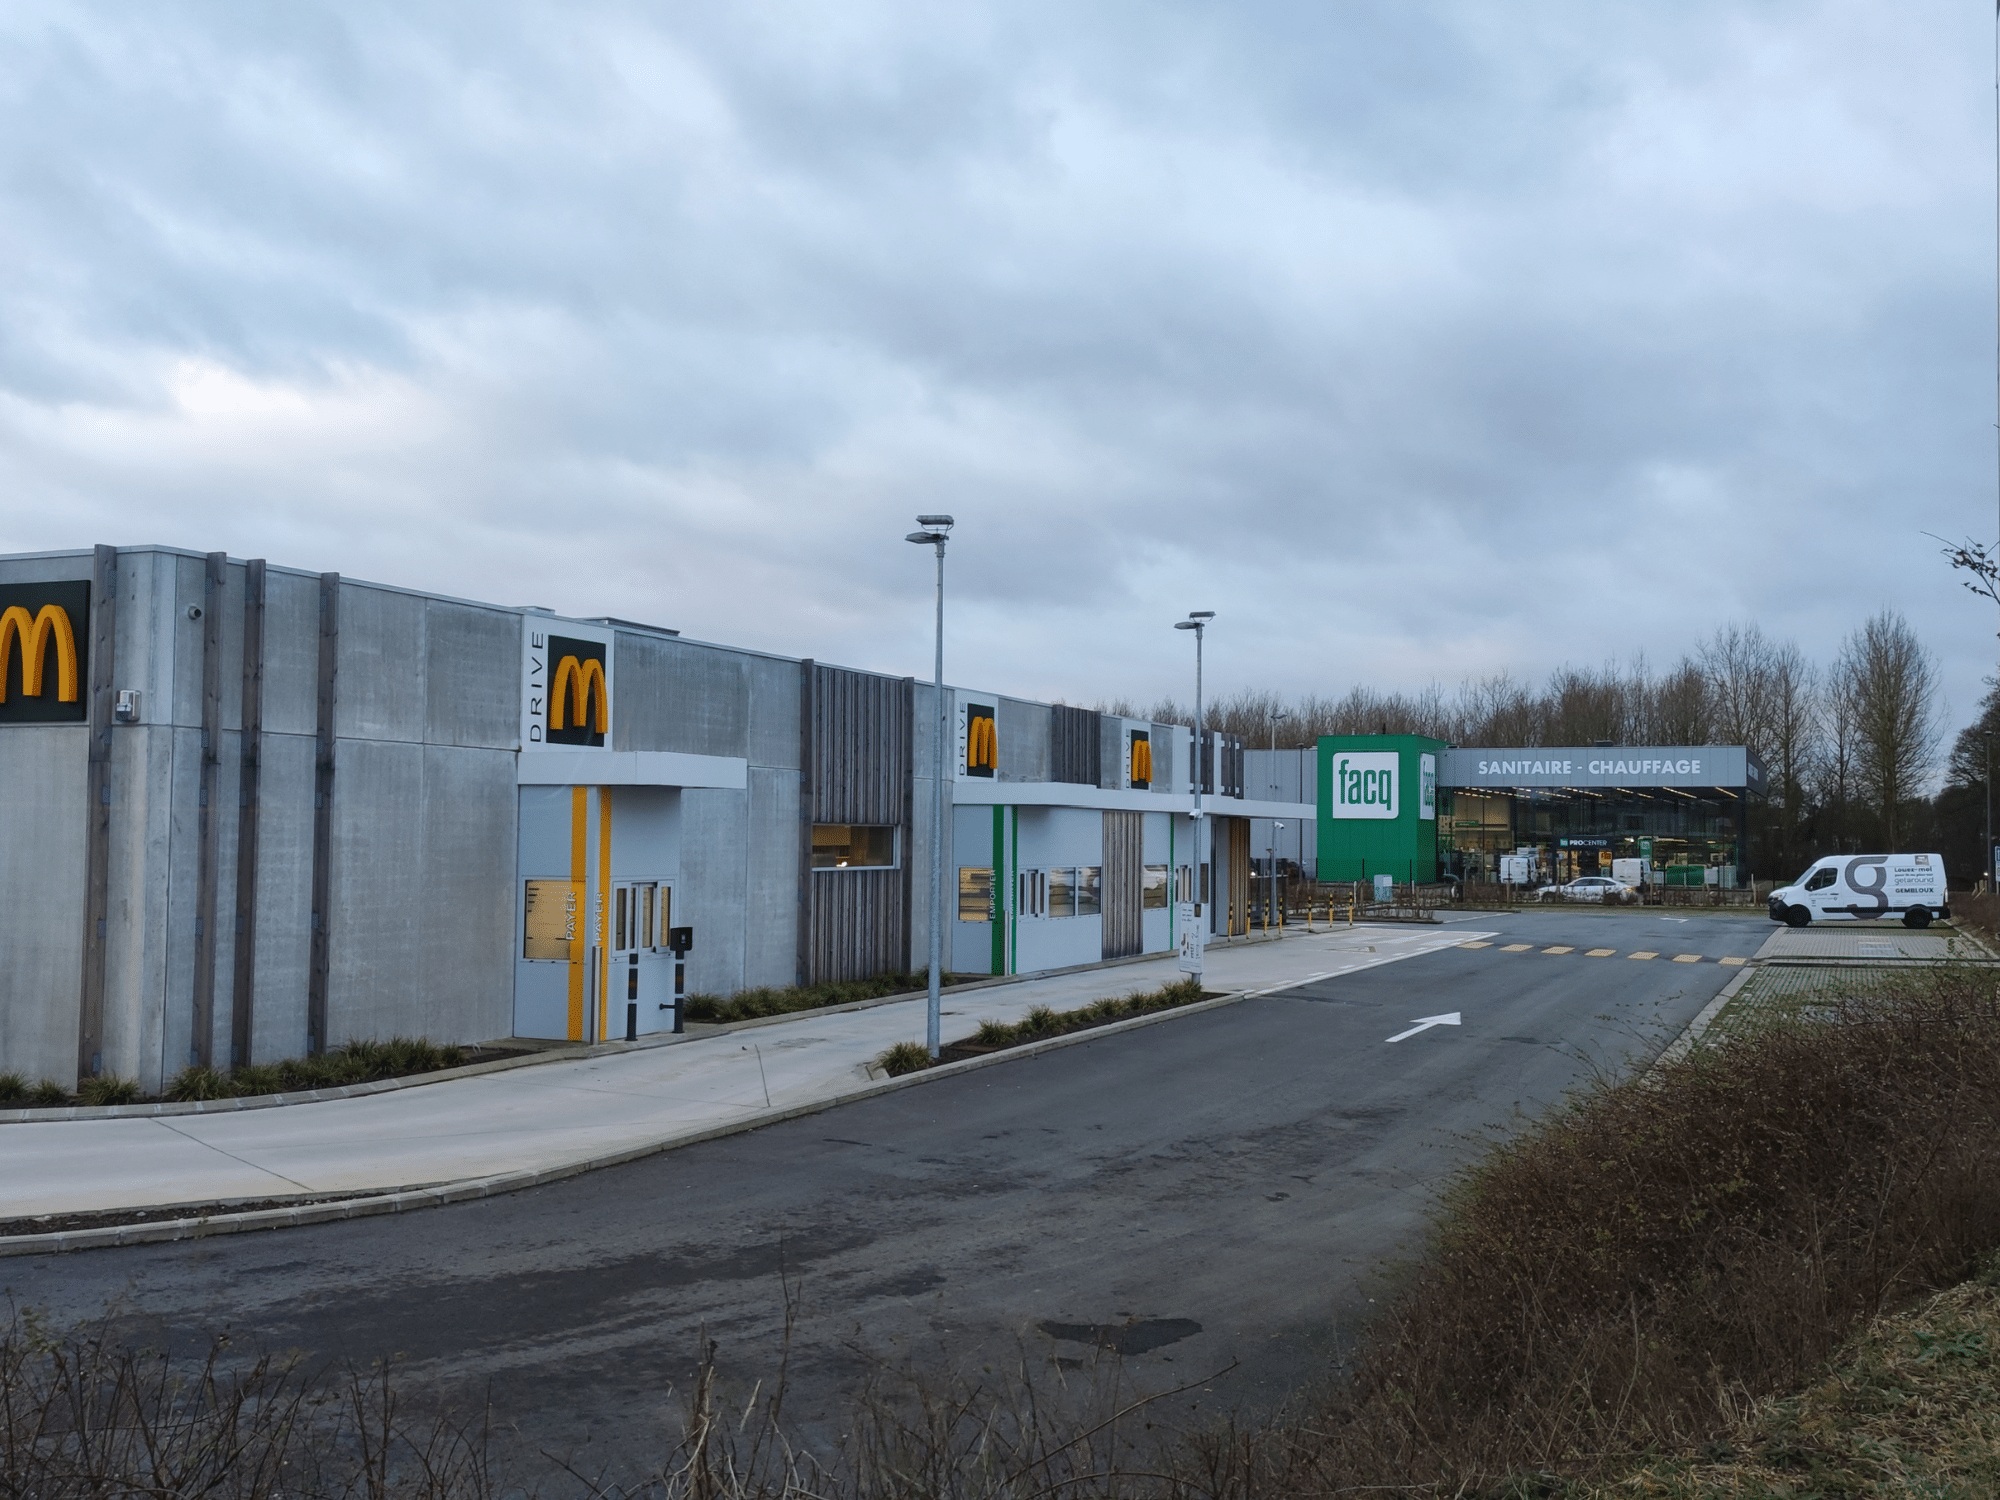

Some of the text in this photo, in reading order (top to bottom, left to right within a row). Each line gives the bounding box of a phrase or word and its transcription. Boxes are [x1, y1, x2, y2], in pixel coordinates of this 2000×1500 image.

[530, 631, 544, 742] DRIVE
[1339, 759, 1391, 811] facq
[1478, 760, 1572, 775] SANITAIRE
[1588, 759, 1701, 775] CHAUFFAGE
[989, 869, 997, 919] EMPORTER
[1894, 877, 1934, 886] getaround
[565, 892, 577, 940] PAYER
[595, 892, 603, 940] PAYER
